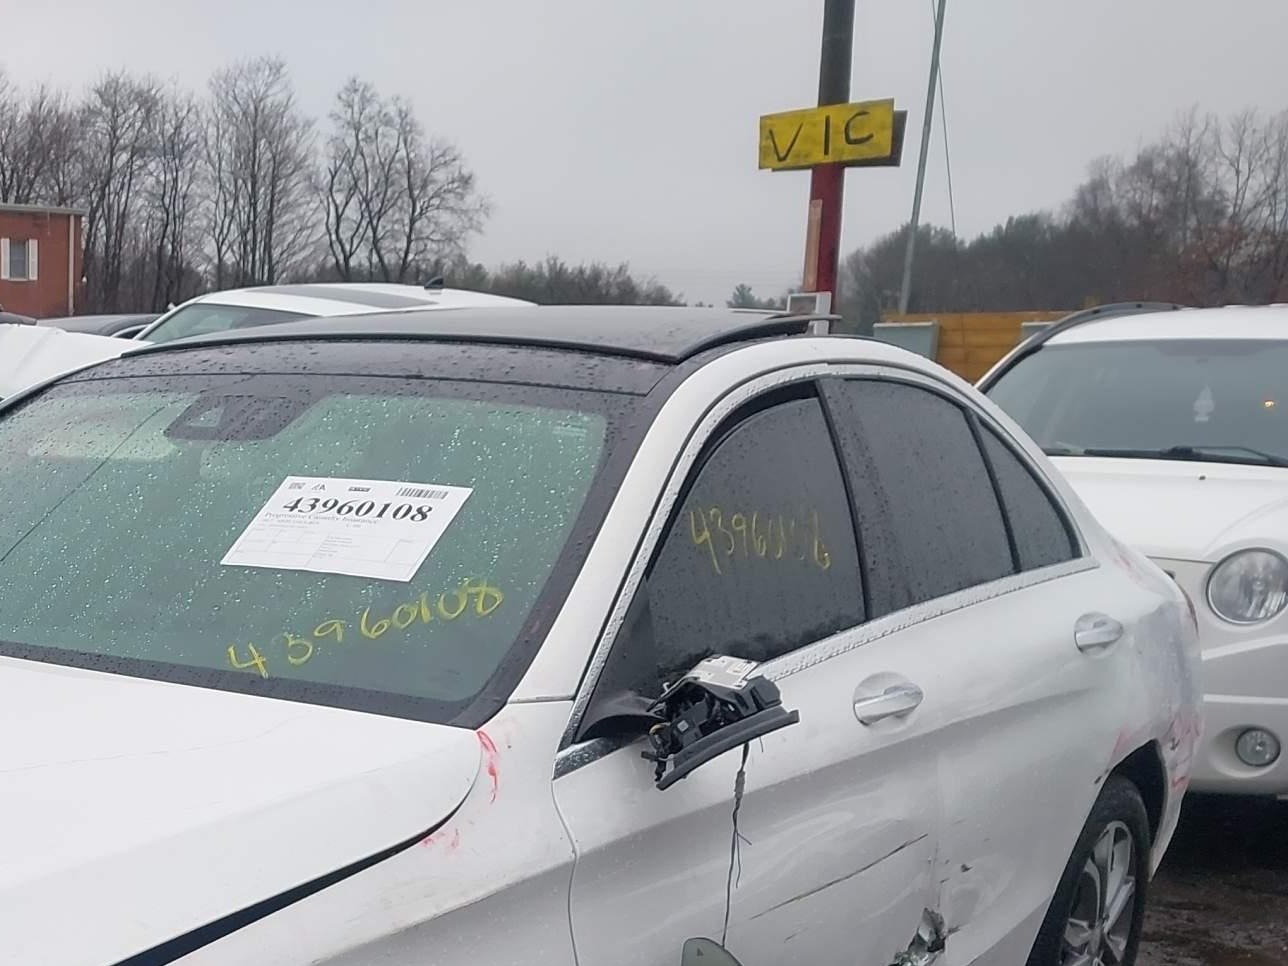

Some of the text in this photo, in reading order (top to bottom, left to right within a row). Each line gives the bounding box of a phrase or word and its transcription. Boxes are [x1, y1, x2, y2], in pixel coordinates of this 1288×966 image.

[768, 111, 874, 162] VIC
[283, 495, 433, 522] 43960108
[227, 577, 505, 679] 43960108
